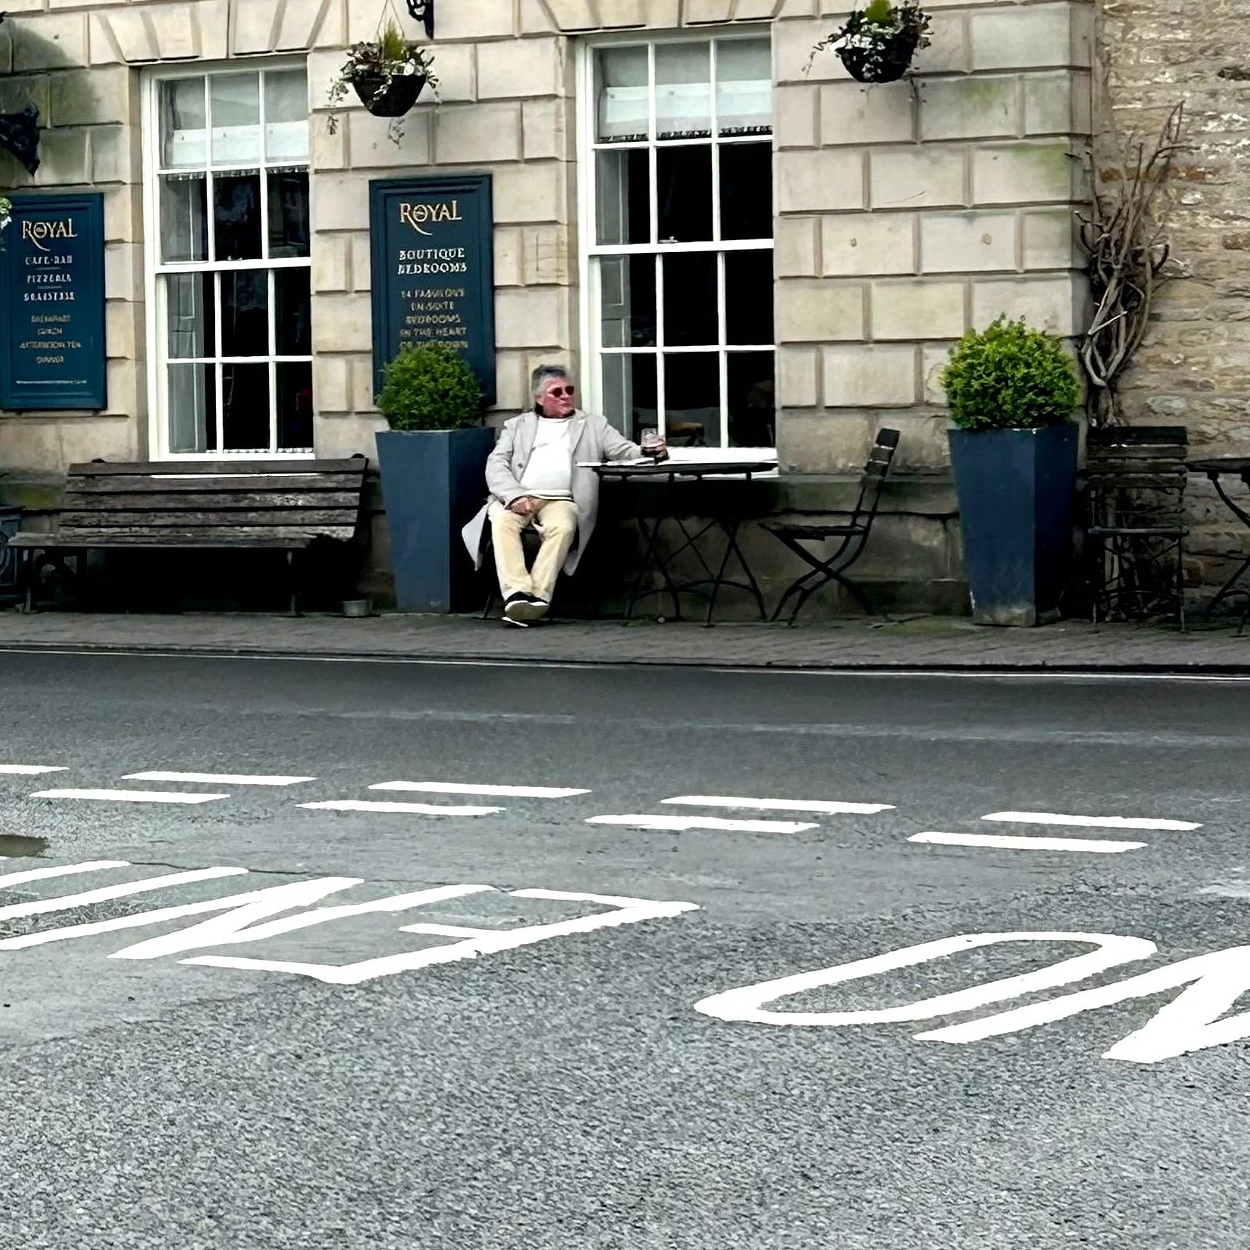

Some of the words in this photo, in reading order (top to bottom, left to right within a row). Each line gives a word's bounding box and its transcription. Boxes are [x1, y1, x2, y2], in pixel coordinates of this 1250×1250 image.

[399, 200, 462, 236] ROYAL
[22, 217, 78, 251] ROYAL
[399, 248, 465, 260] BOUTIQUE
[398, 262, 467, 275] BEDROOMS
